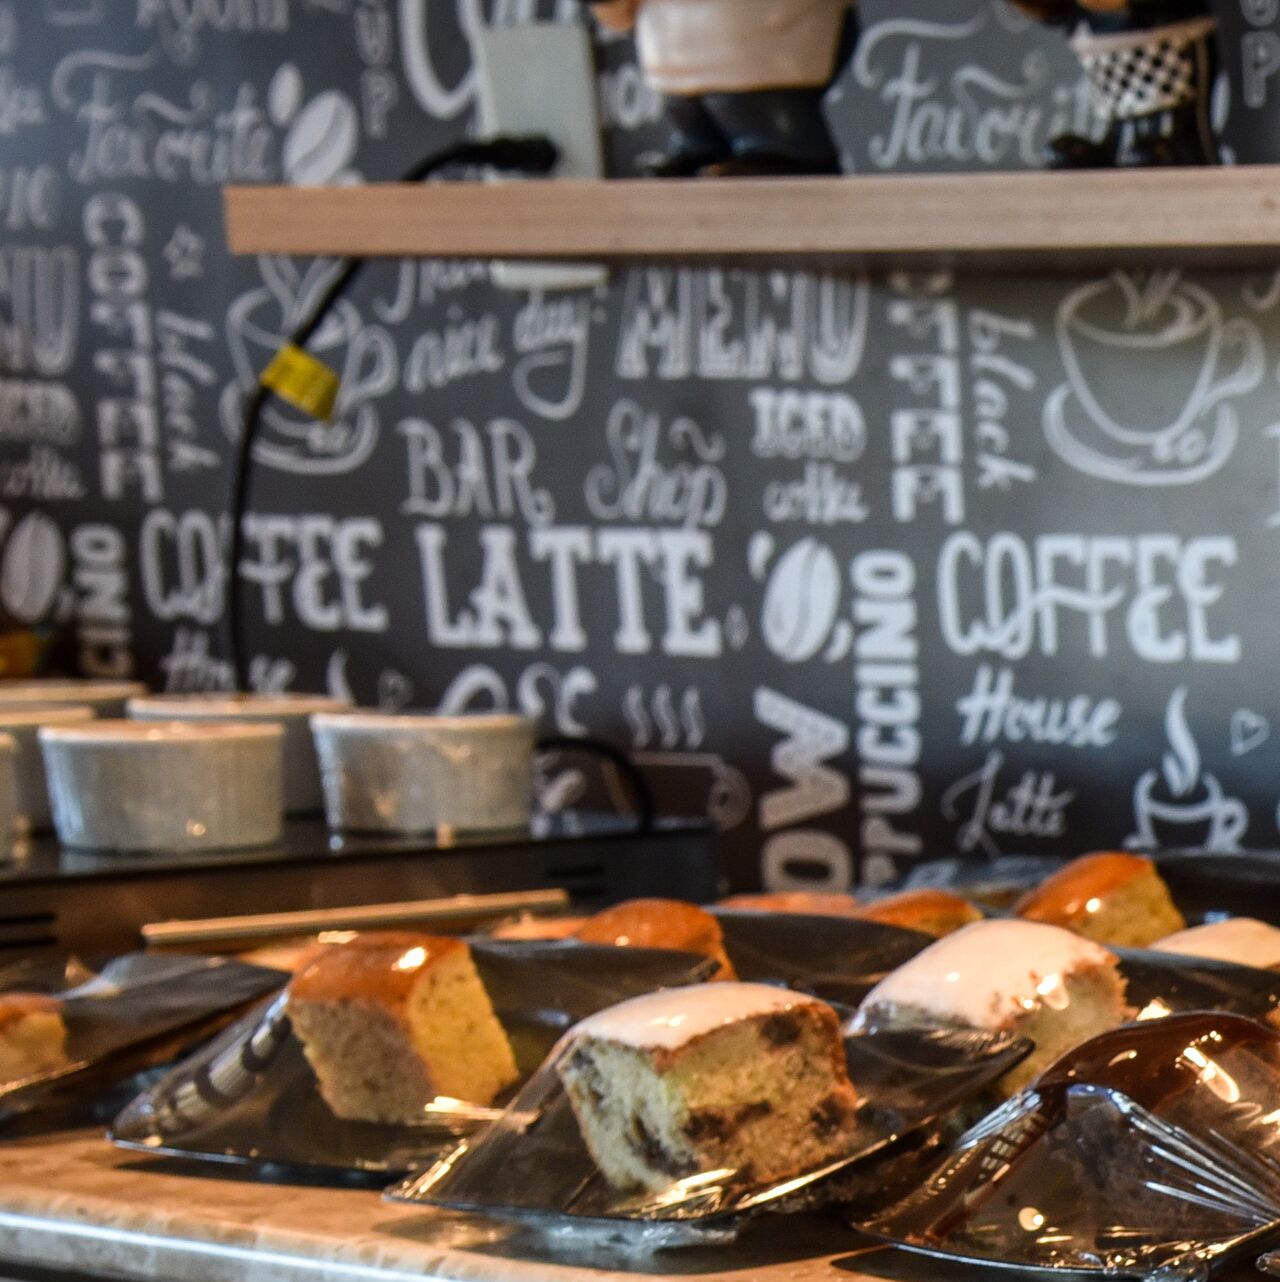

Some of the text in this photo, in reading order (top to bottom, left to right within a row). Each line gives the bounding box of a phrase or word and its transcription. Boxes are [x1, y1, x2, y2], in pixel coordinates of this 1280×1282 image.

[395, 415, 557, 528] BAR
[416, 522, 723, 658] LATTE
[936, 529, 1243, 664] COFFEE
[956, 660, 1124, 749] House
